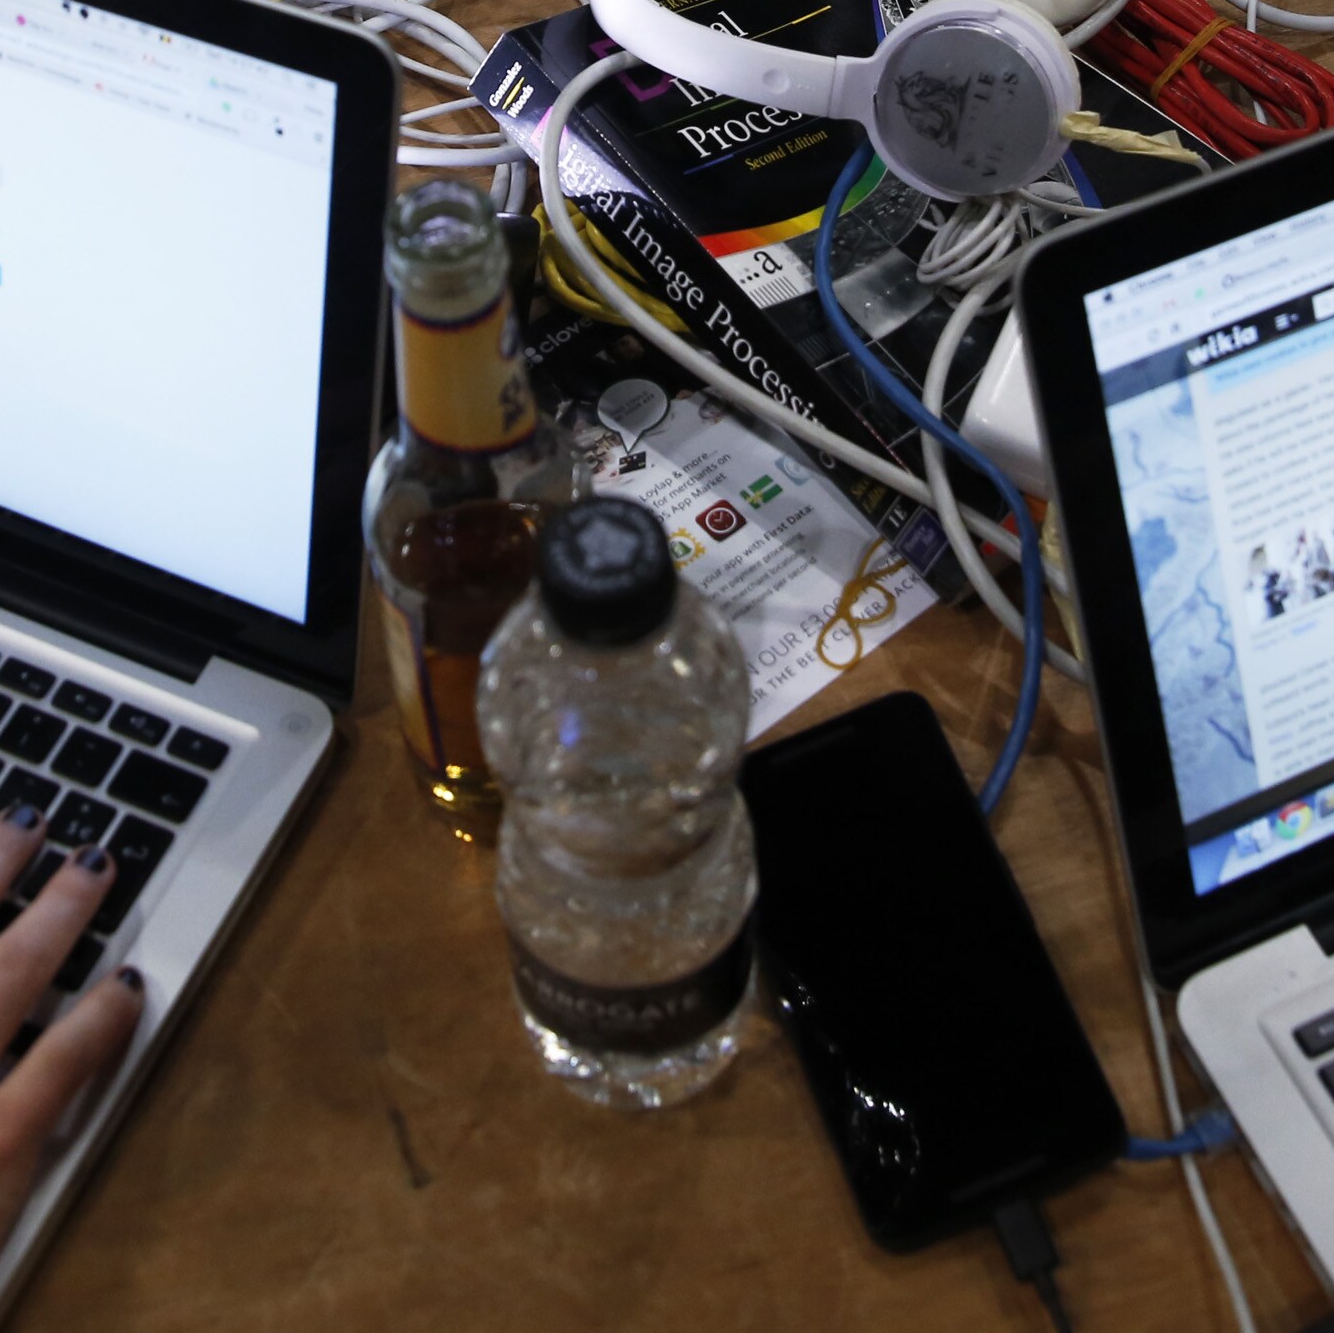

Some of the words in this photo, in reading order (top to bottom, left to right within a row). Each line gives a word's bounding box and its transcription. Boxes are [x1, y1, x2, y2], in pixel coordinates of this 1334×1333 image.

[489, 61, 523, 107] Gonzalez
[507, 84, 534, 117] Woods
[677, 103, 803, 159] Proces
[745, 140, 784, 170] Second
[786, 129, 829, 156] Edition
[539, 316, 594, 353] clove
[622, 205, 705, 312] Image
[705, 301, 838, 470] Processi
[1186, 325, 1259, 367] wikia
[639, 477, 673, 503] Loylap
[673, 469, 682, 479] &
[652, 498, 670, 514] for
[670, 466, 716, 500] merchants
[717, 453, 732, 467] on
[671, 499, 693, 520] App
[693, 472, 727, 500] Market
[725, 552, 744, 574] app
[744, 537, 766, 557] with
[763, 520, 789, 542] First
[788, 504, 814, 526] Data
[758, 631, 802, 668] OUR
[769, 667, 798, 690] THE
[832, 600, 883, 642] CLVER
[894, 573, 921, 598] ACK
